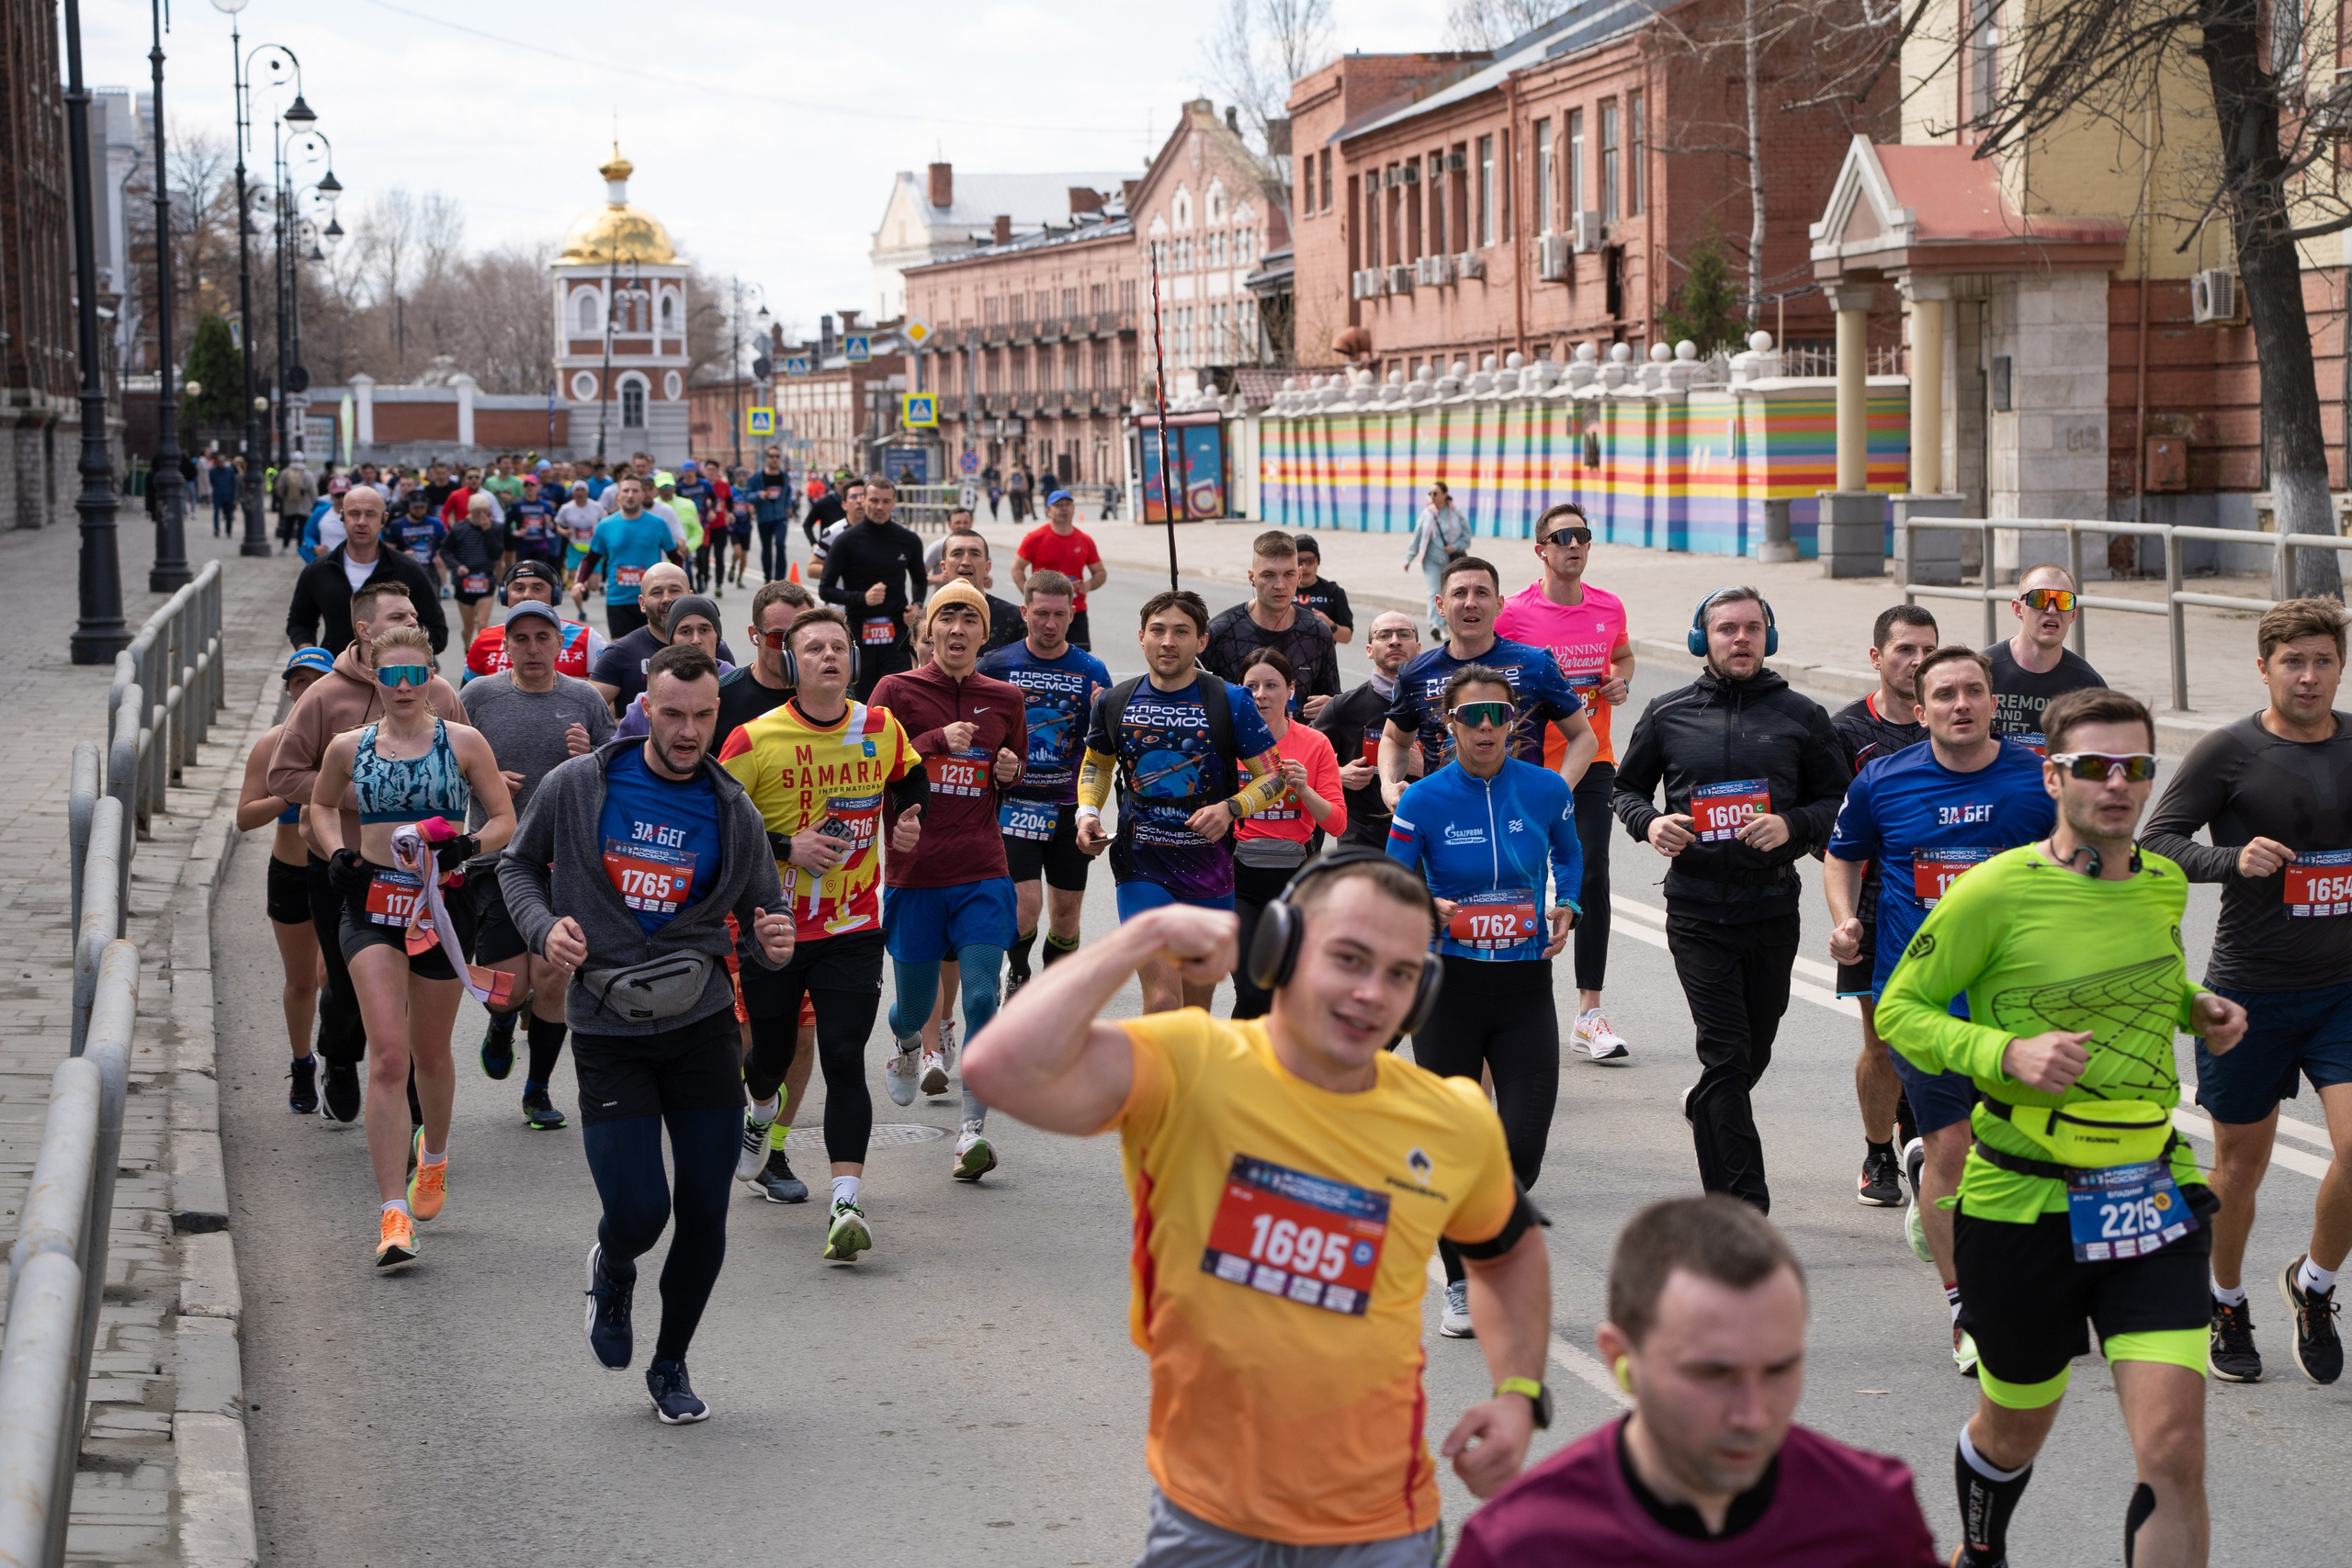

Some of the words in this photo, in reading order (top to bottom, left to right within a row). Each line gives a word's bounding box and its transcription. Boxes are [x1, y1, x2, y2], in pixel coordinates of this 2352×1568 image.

[1550, 642, 1607, 657] UNNING
[1557, 652, 1605, 671] Sarcasm
[1995, 709, 2022, 721] AND
[782, 760, 883, 789] SAMARA
[941, 764, 975, 784] 1213
[1010, 812, 1046, 831] 2204
[1455, 828, 1484, 838] GAZPROM
[621, 869, 672, 898] 1765
[676, 880, 684, 888] D
[2306, 875, 2352, 902] 1654
[387, 893, 418, 915] 117
[1470, 914, 1517, 938] 1762
[1525, 920, 1533, 929] D
[2086, 1135, 2120, 1145] RUNNING
[2099, 1196, 2163, 1238] 2215
[1250, 1213, 1351, 1280] 1695
